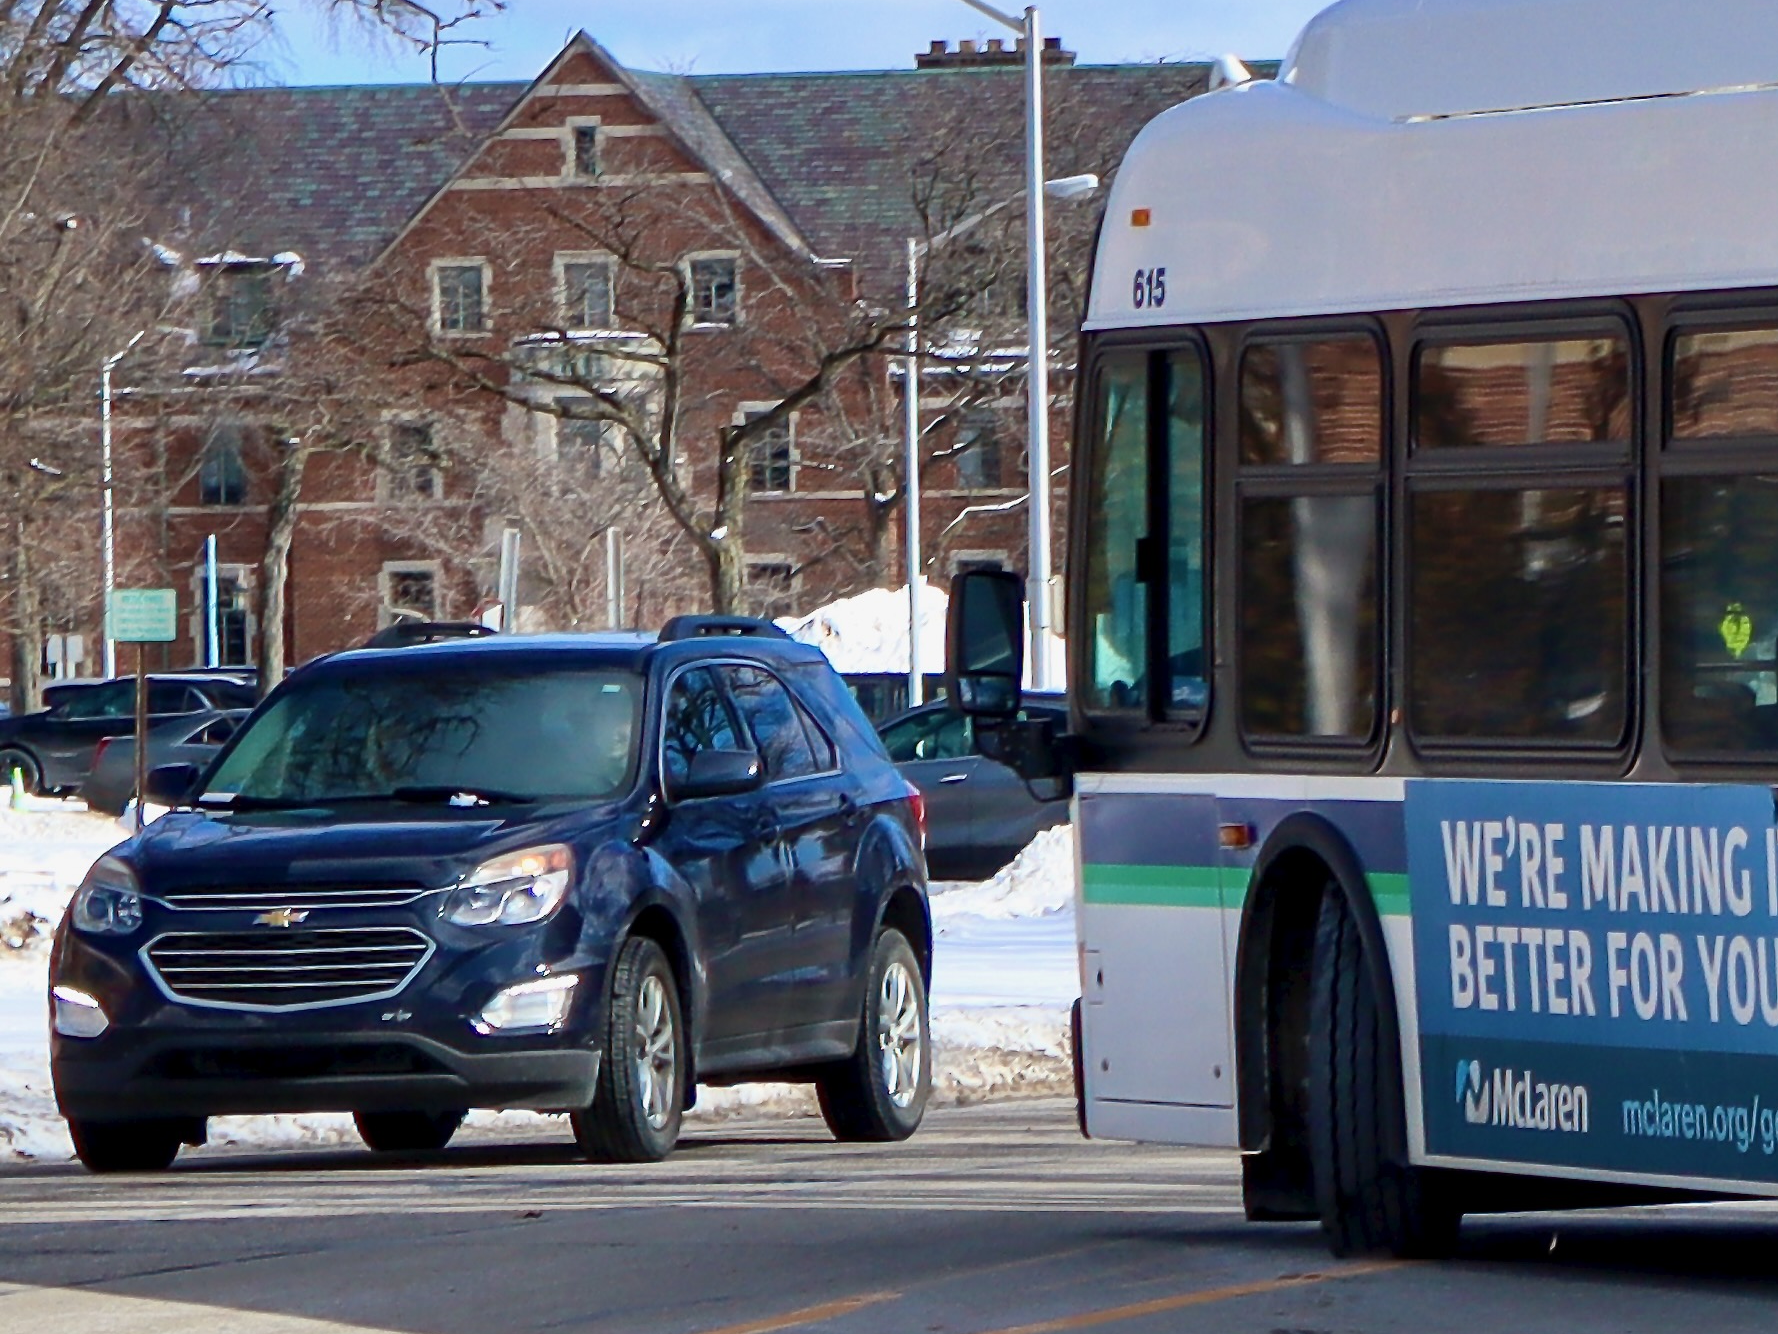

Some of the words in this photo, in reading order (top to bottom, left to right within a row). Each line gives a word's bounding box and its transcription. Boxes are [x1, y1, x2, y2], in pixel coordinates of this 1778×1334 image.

[1133, 267, 1166, 309] 615
[1441, 815, 1568, 910] WE'RE
[1579, 823, 1752, 917] MAKING
[1449, 924, 1596, 1017] BETTER
[1607, 931, 1688, 1022] FOR
[1492, 1068, 1589, 1133] McLaren
